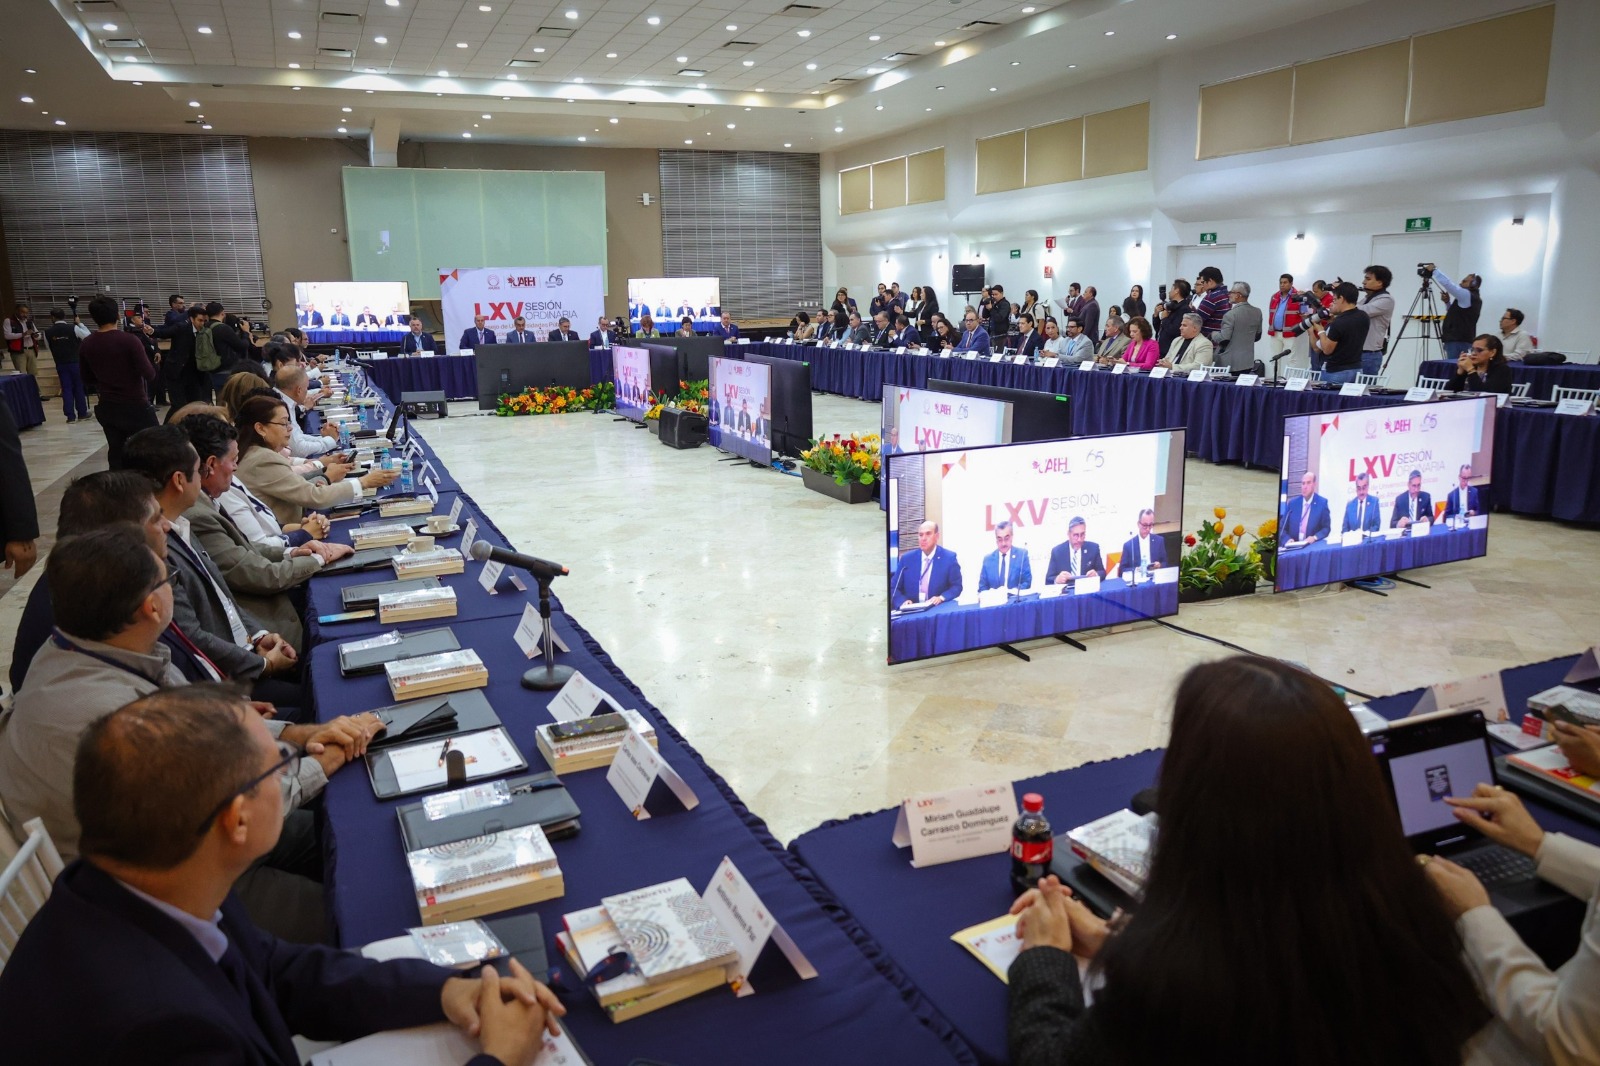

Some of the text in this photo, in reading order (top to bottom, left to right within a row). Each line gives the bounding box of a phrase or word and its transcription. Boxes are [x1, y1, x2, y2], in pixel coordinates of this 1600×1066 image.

[474, 301, 524, 320] LXV
[525, 300, 562, 310] SESIÓN
[525, 310, 578, 320] ORDINARIA
[724, 383, 739, 399] LXV
[914, 425, 943, 449] LXV
[1349, 453, 1397, 482] LXV
[985, 497, 1050, 532] LXV
[956, 805, 1000, 818] Guadalupe
[920, 824, 961, 837] Carrasco
